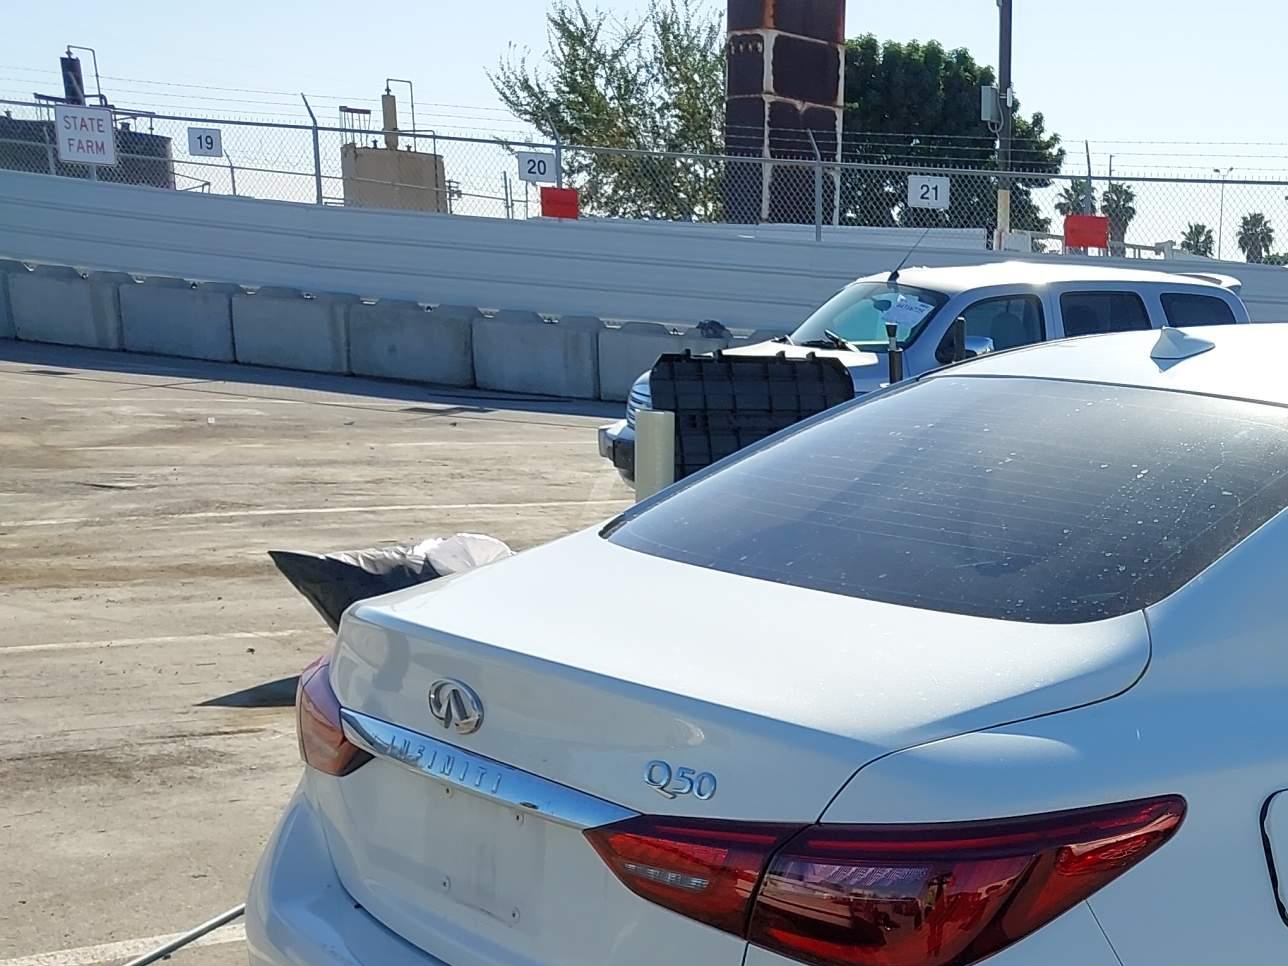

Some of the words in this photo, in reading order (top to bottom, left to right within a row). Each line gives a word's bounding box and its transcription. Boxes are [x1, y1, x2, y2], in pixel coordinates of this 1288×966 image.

[63, 115, 105, 133] STATE
[67, 138, 106, 155] FARM
[197, 134, 214, 150] 19
[527, 159, 547, 175] 20
[919, 184, 939, 200] 21
[644, 759, 717, 801] Q50
